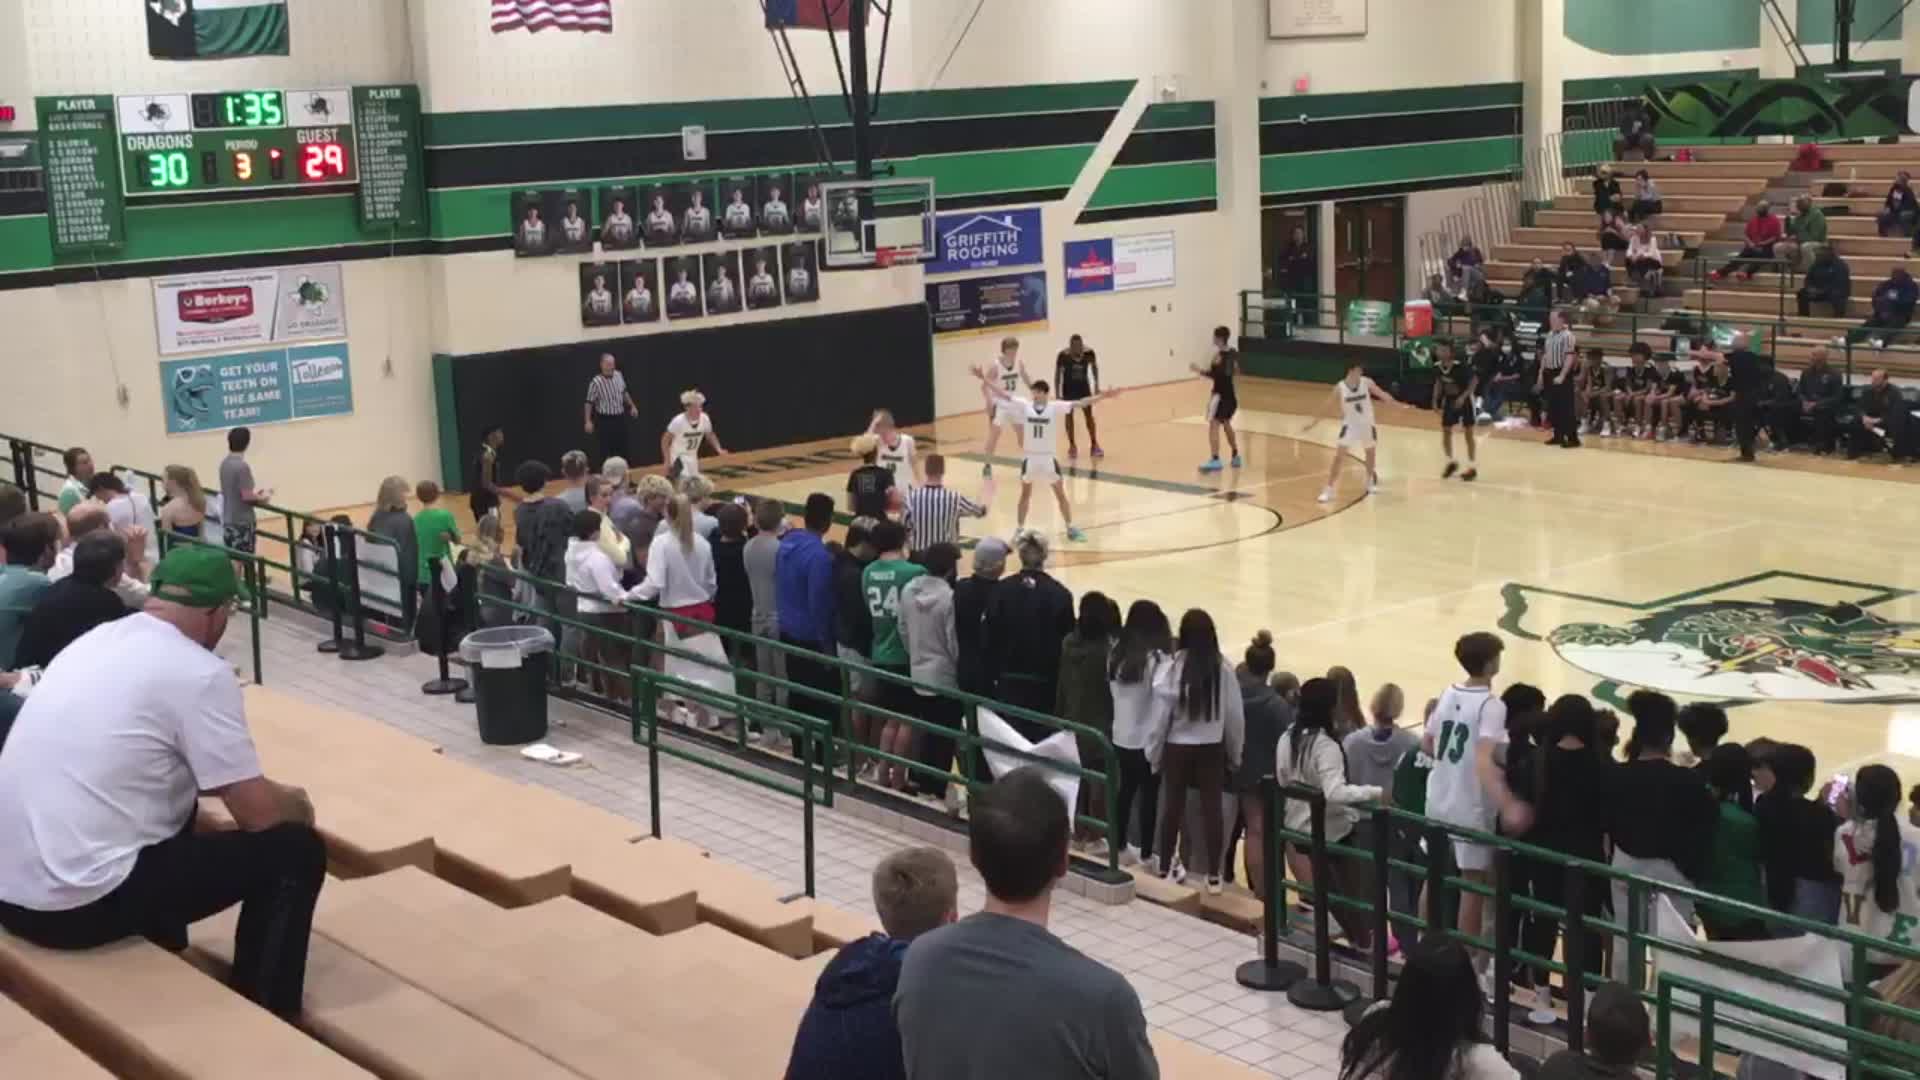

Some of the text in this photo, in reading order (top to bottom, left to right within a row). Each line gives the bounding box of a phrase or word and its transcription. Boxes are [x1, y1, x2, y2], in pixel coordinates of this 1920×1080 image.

[368, 88, 402, 99] PLAYER
[57, 100, 96, 110] PLAYER
[225, 93, 281, 125] 1:35
[127, 134, 193, 151] DRAGONS
[297, 128, 338, 144] GUEST
[148, 153, 189, 186] 30
[235, 152, 251, 179] 3
[306, 145, 343, 177] 29
[946, 231, 1018, 247] GRIFFITH
[947, 242, 1018, 260] ROOFING
[220, 361, 279, 377] GET YOUR
[221, 376, 278, 391] TEETH ON
[223, 390, 281, 405] THE SAME
[867, 585, 899, 617] 24
[1437, 720, 1469, 764] 13
